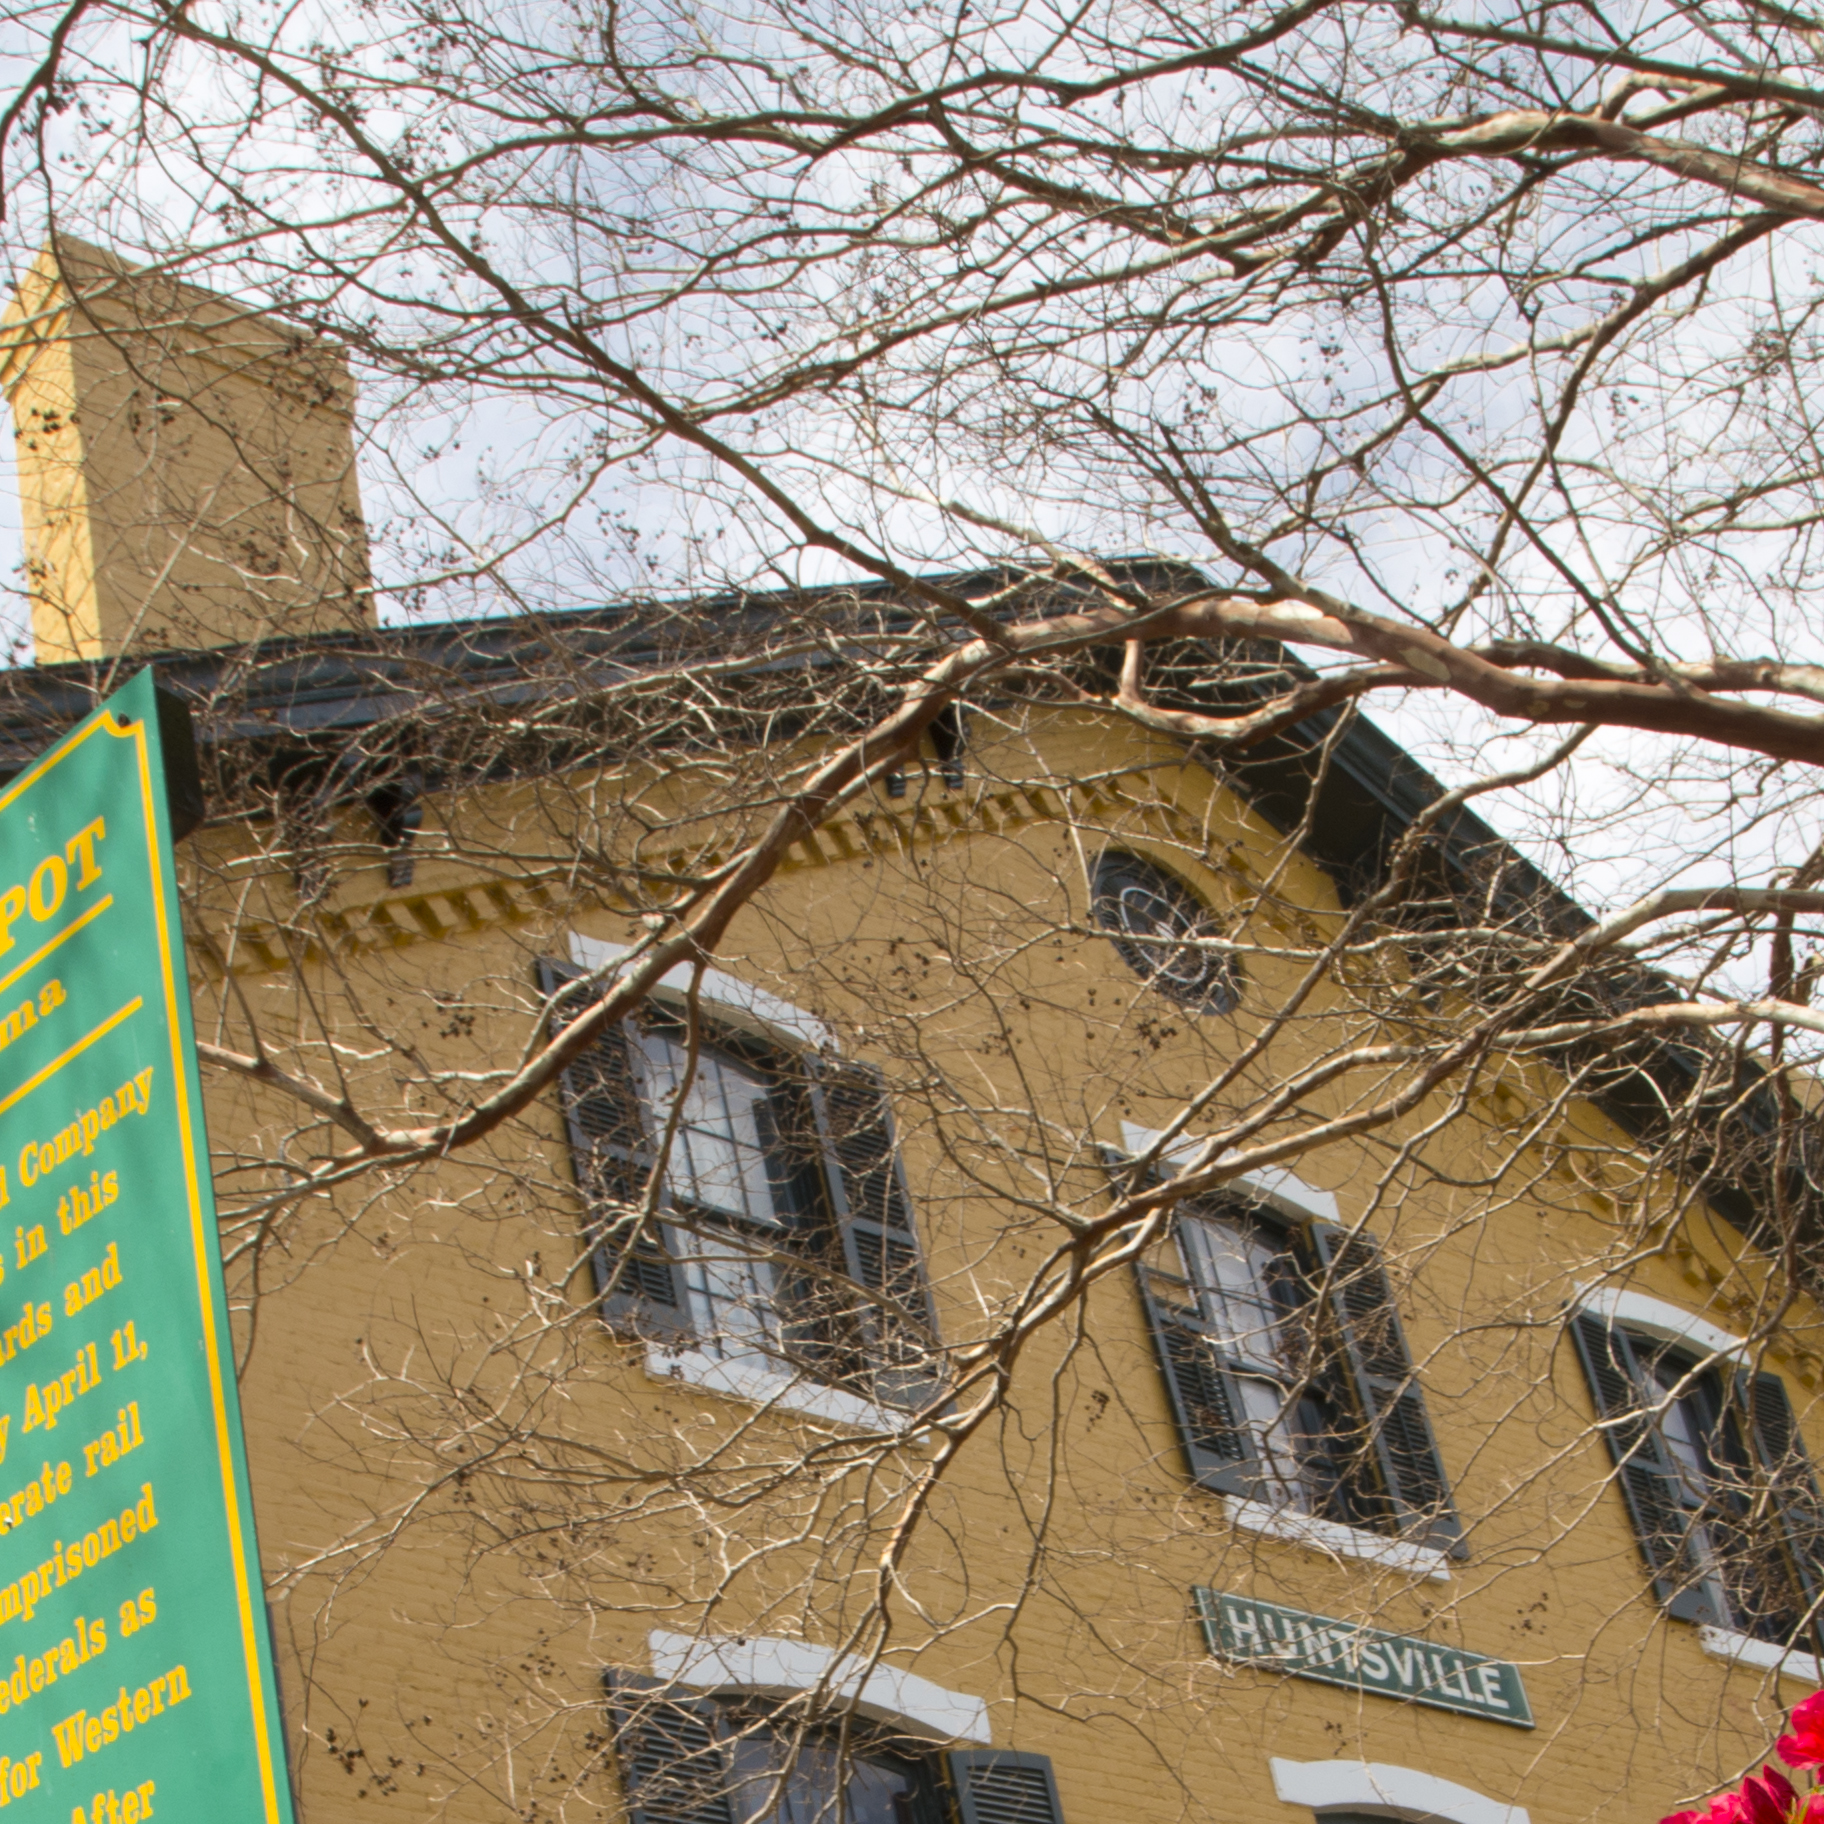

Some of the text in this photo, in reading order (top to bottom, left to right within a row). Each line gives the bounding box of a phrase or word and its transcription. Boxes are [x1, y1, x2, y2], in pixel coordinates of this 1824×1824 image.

[17, 1065, 155, 1189] Company
[13, 1223, 50, 1271] in
[55, 1169, 121, 1237] this
[62, 1240, 125, 1319] and
[20, 1340, 103, 1435] April
[109, 1319, 150, 1373] 11,
[82, 1400, 146, 1479] rail
[117, 1586, 159, 1639] as
[1225, 1604, 1510, 1710] HUNTSVILLE
[50, 1663, 193, 1770] Western
